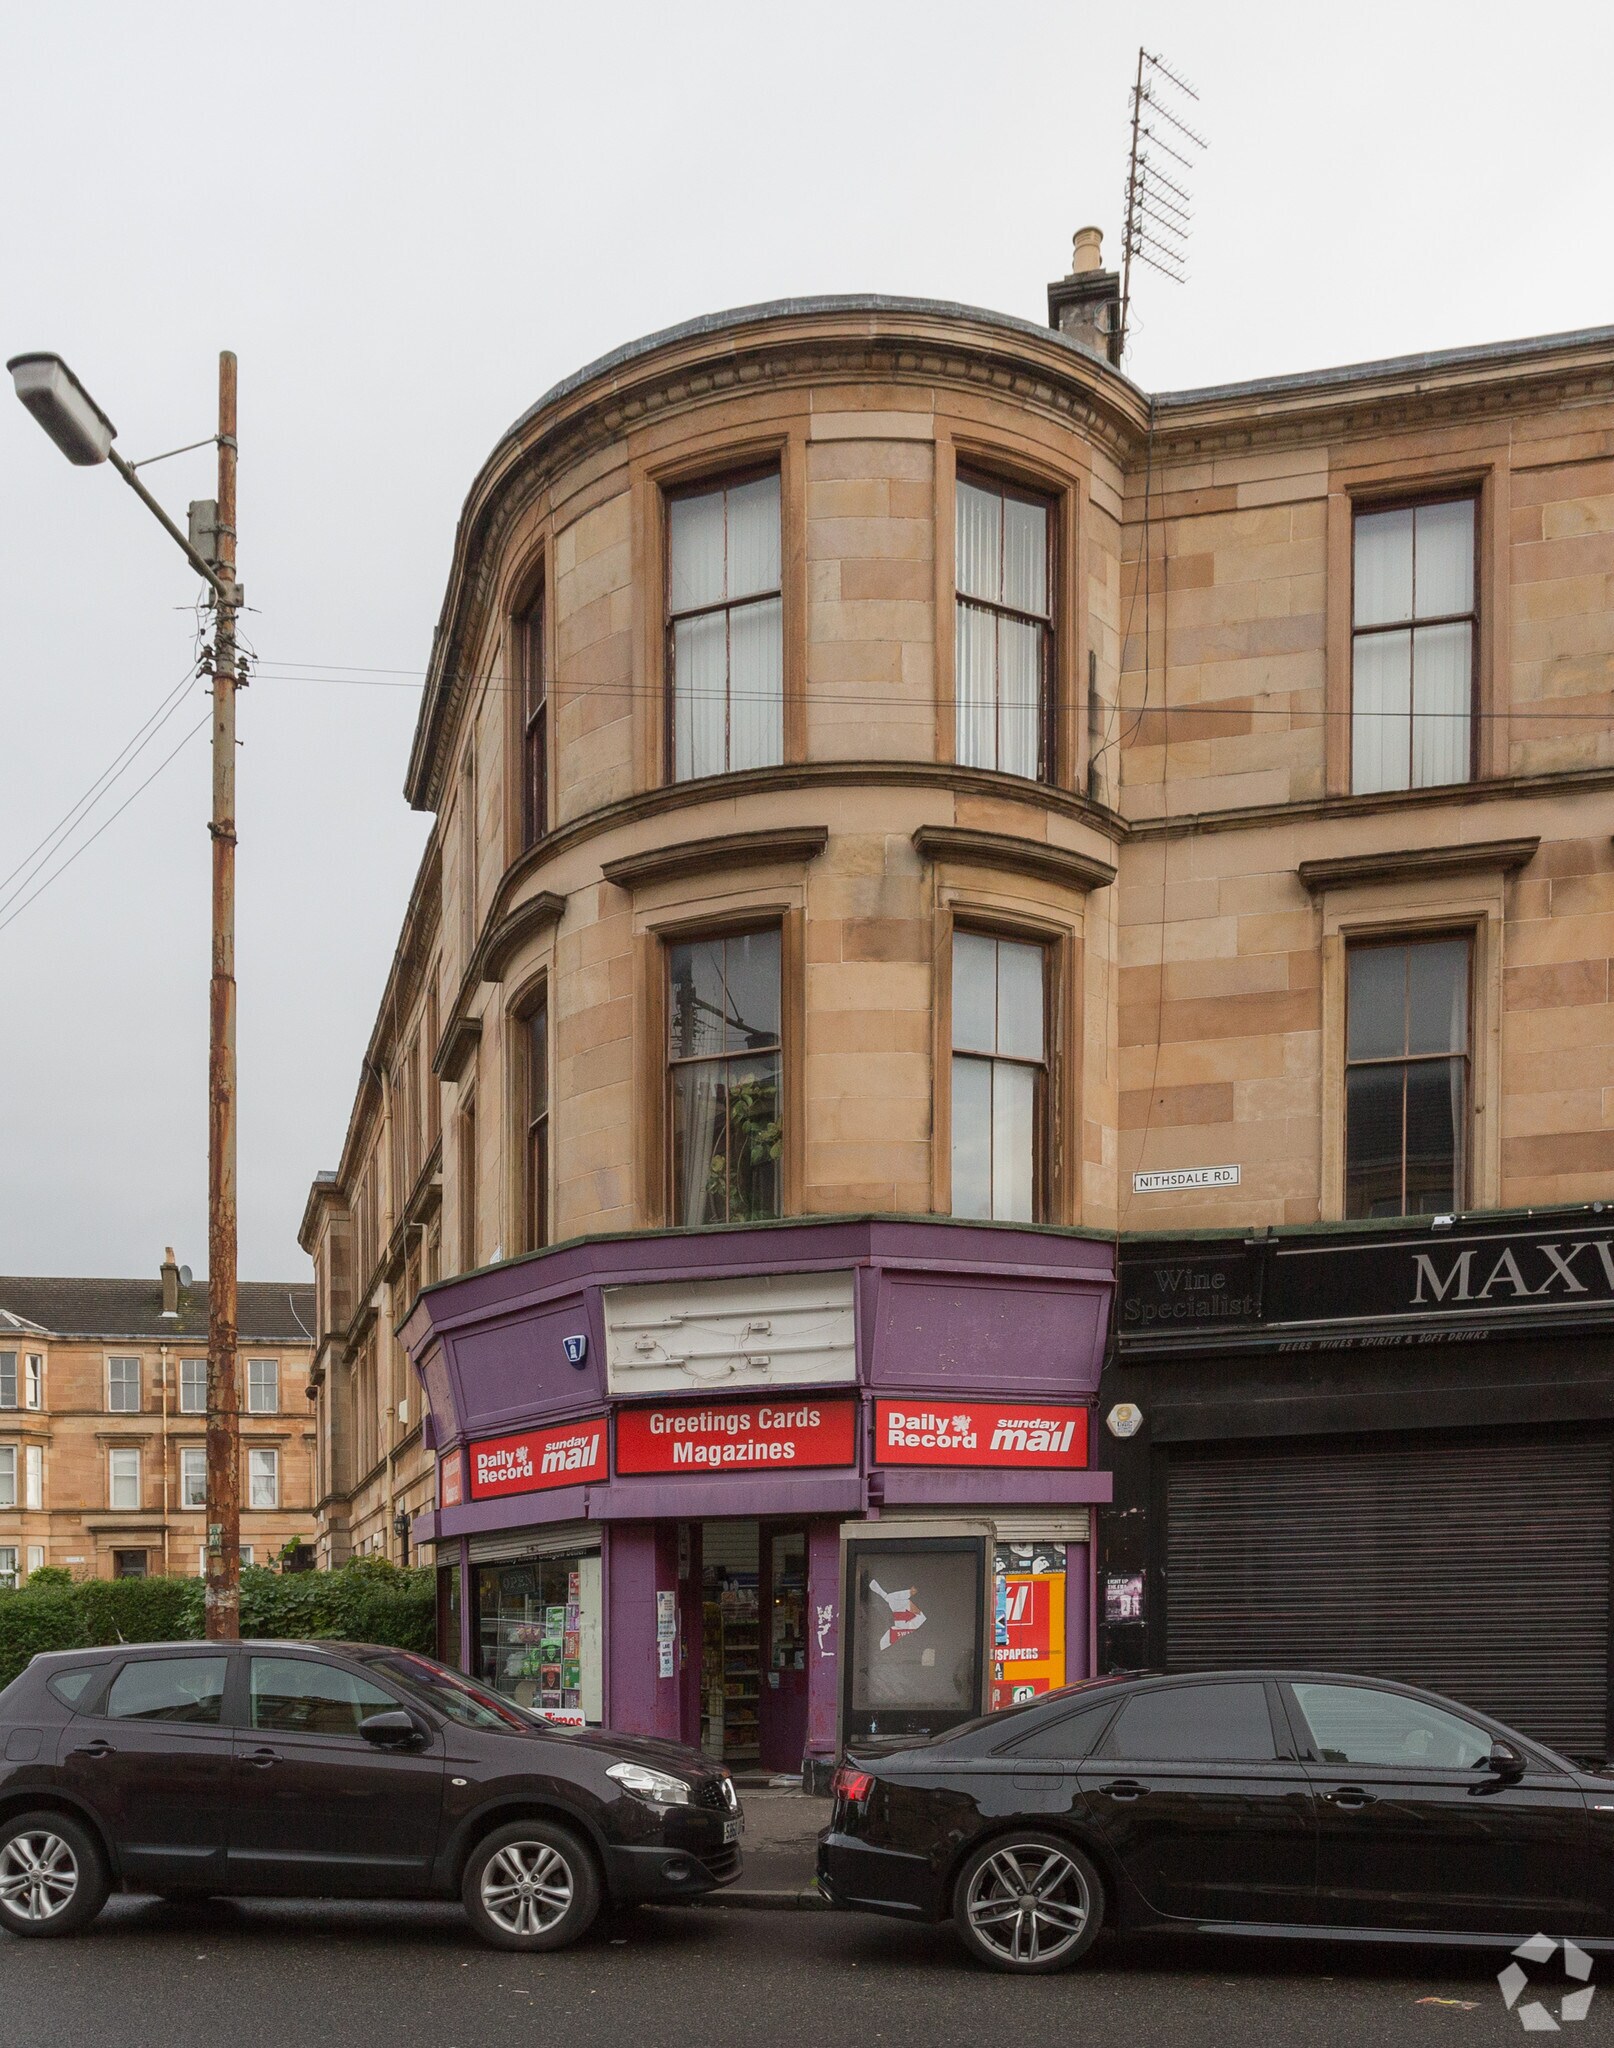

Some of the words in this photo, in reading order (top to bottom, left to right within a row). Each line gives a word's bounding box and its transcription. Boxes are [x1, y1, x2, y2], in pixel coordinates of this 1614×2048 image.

[1139, 1171, 1209, 1187] NITHSDALE
[1214, 1169, 1233, 1181] RD.
[1154, 1269, 1226, 1292] Wine
[1278, 1343, 1311, 1352] BEERS
[1319, 1339, 1353, 1350] WINES
[1360, 1336, 1401, 1347] SPIRITS
[1405, 1336, 1412, 1344] &
[1418, 1333, 1444, 1344] SOFT
[1447, 1330, 1489, 1341] DRINKS
[649, 1412, 751, 1436] Greetings
[758, 1407, 821, 1429] Cards
[888, 1413, 949, 1436] Daily
[997, 1418, 1060, 1431] sunday
[544, 1435, 588, 1452] sunday
[888, 1429, 977, 1449] Record
[990, 1421, 1075, 1452] mail
[477, 1449, 515, 1469] Daily
[541, 1434, 600, 1474] mail
[673, 1440, 796, 1467] Magazines
[478, 1461, 533, 1484] Record
